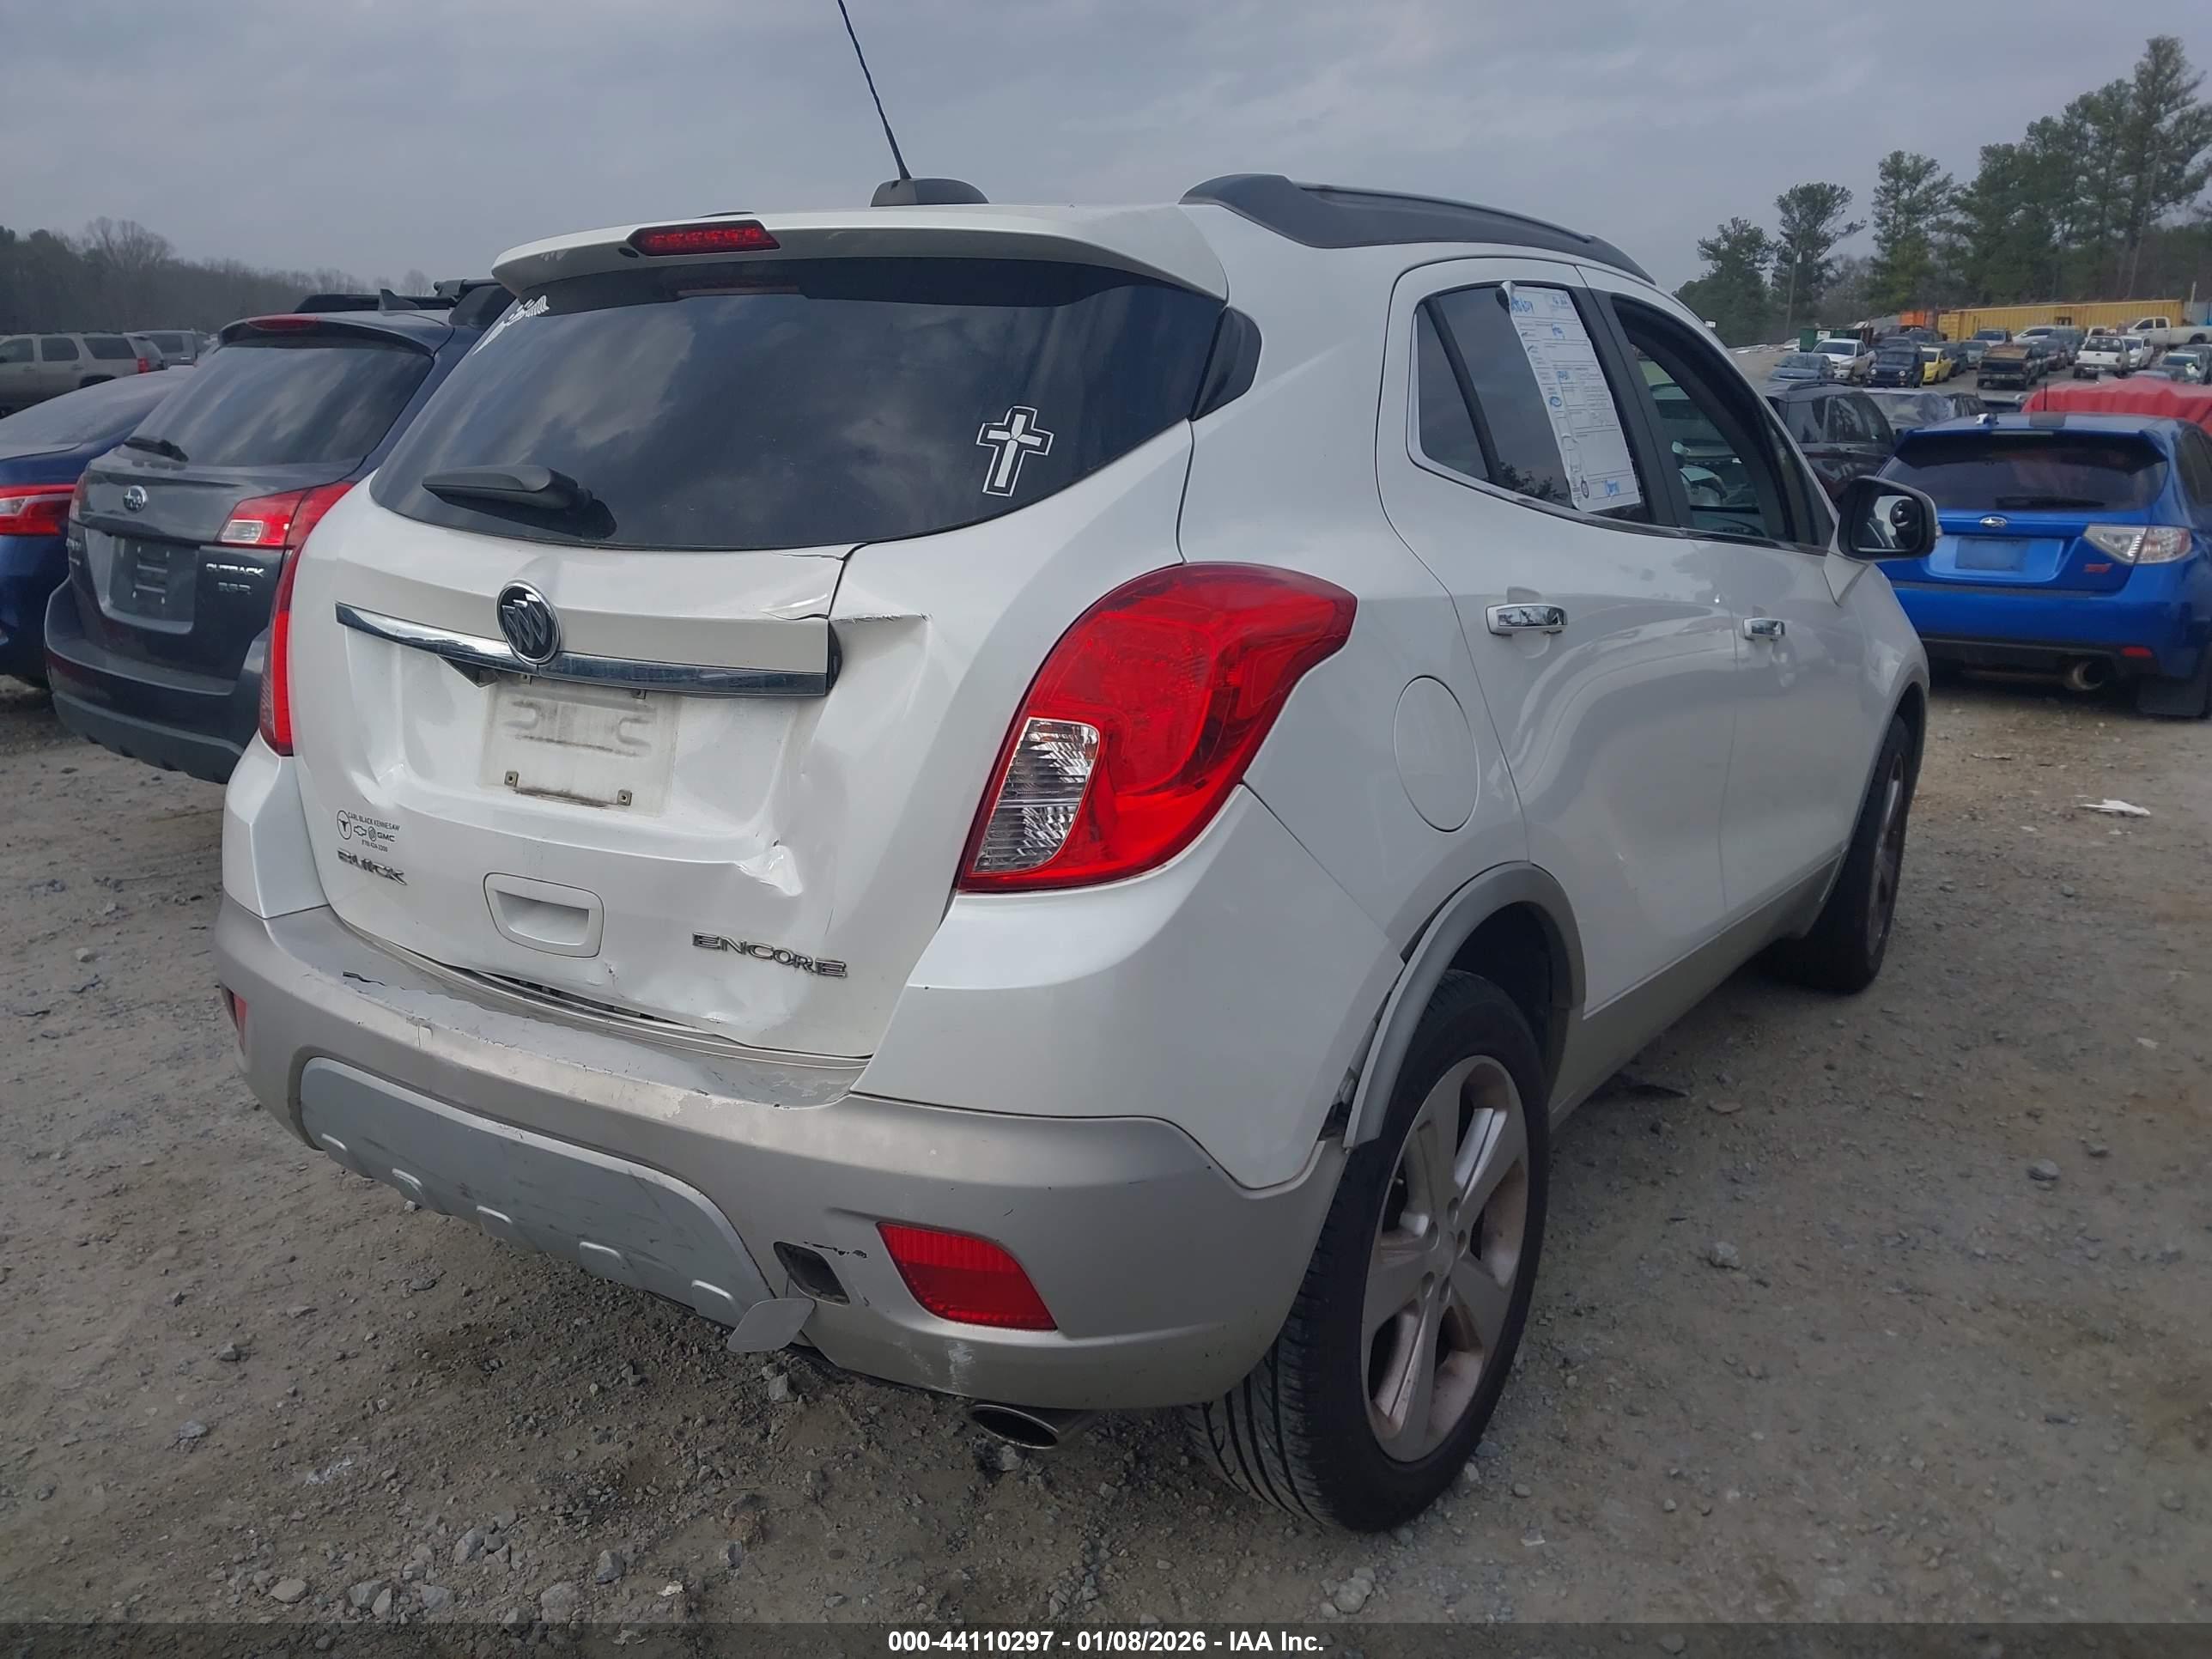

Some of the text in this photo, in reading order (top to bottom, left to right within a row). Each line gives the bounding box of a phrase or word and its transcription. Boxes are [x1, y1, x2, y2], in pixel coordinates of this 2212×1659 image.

[358, 815, 374, 825] BLACK
[377, 832, 396, 842] GMC
[691, 932, 848, 978] ENCORE
